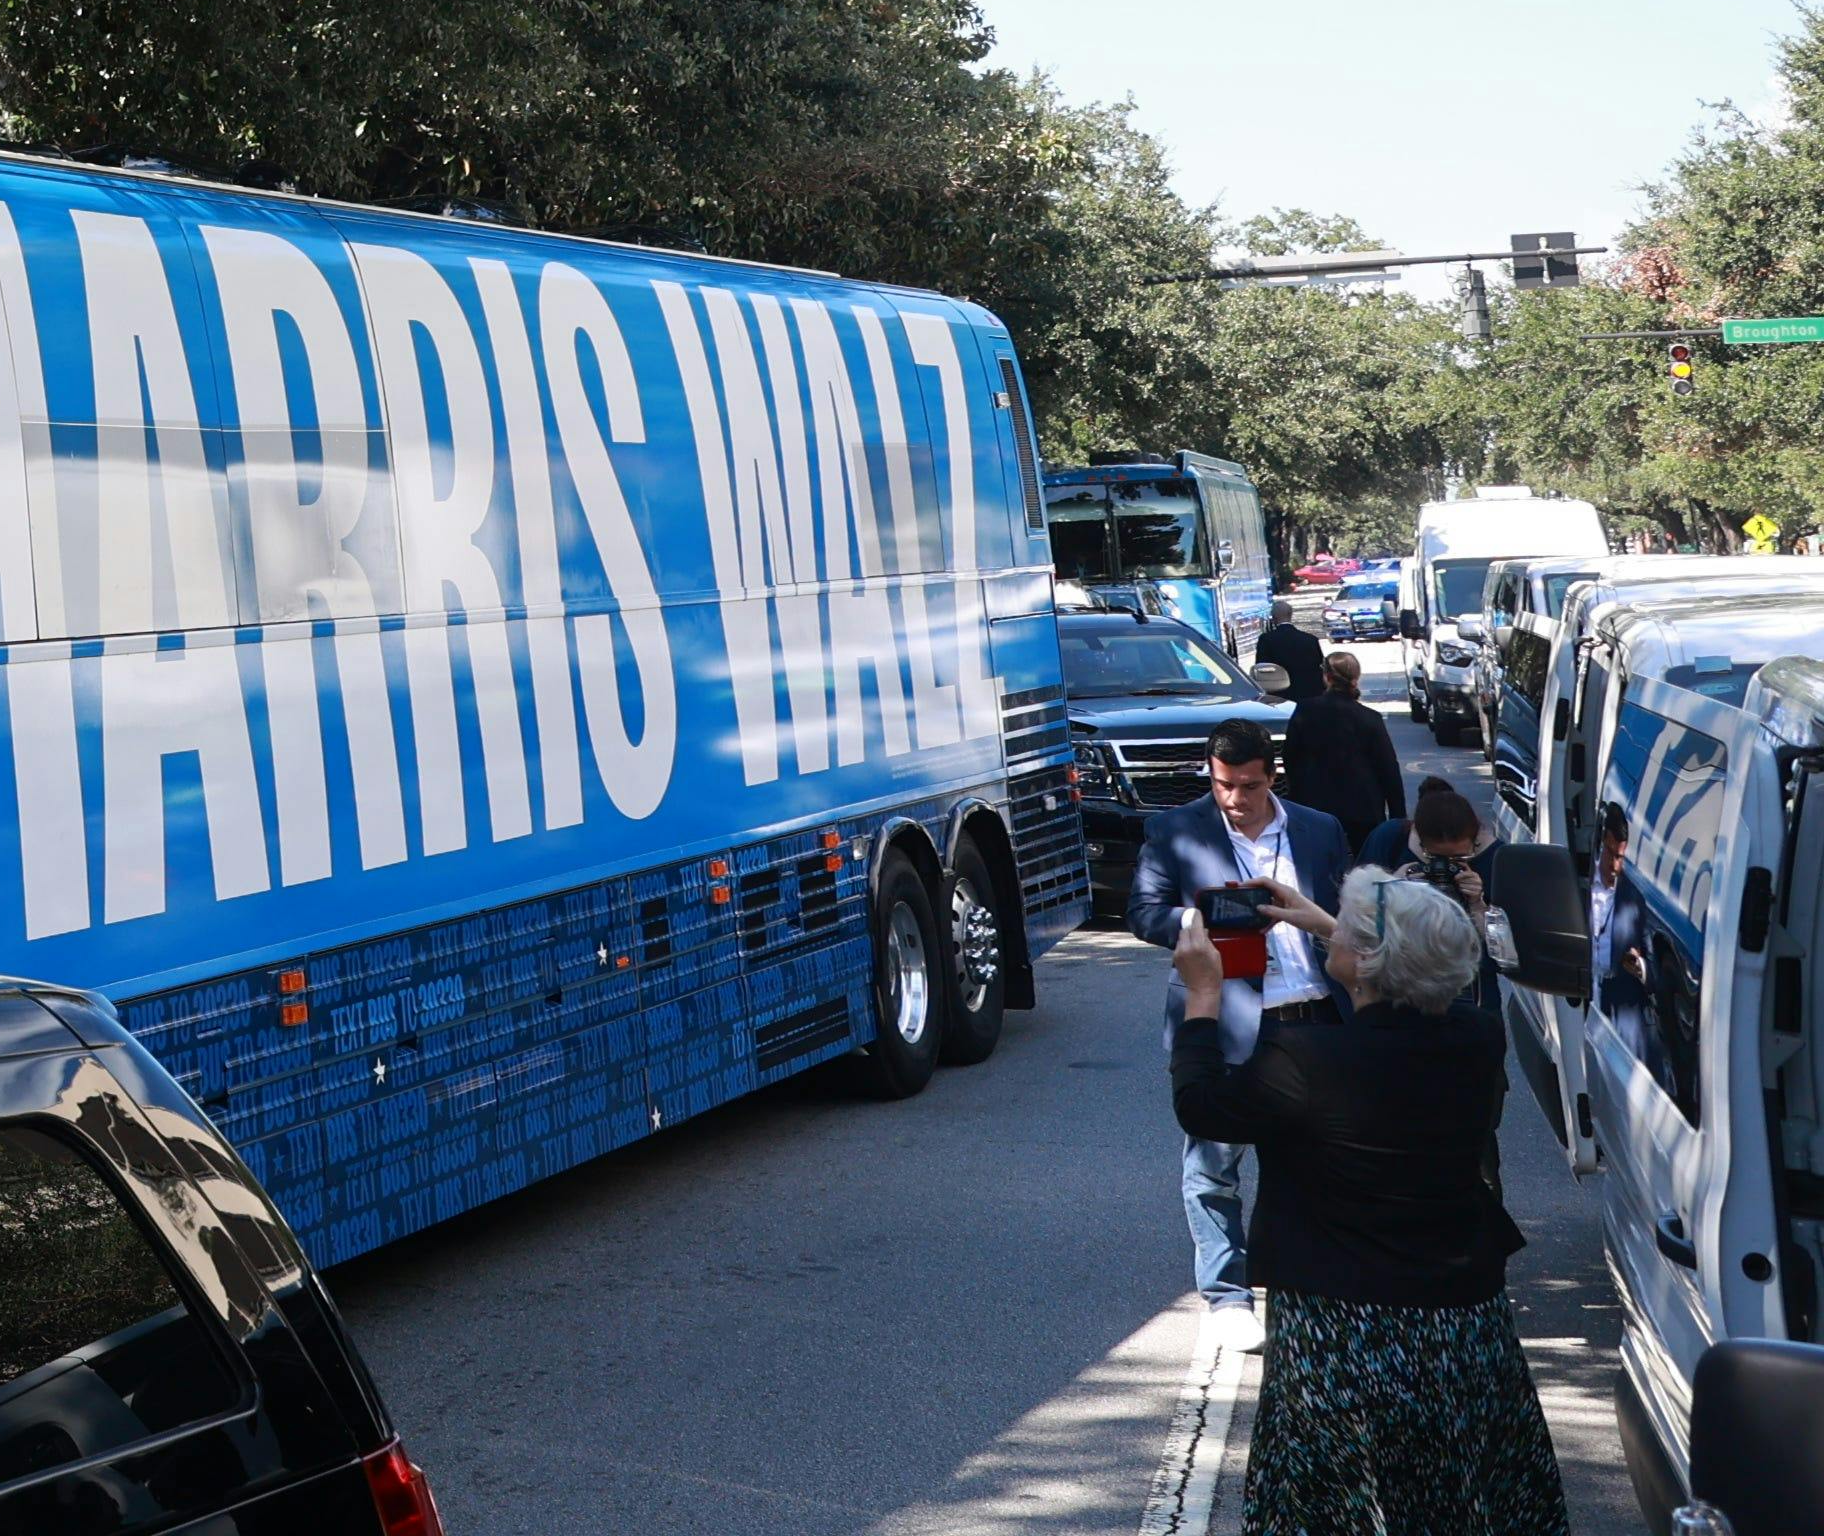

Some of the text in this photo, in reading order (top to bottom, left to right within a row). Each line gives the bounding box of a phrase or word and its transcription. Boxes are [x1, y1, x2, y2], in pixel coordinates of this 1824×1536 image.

[1733, 324, 1817, 340] Broughton
[648, 280, 1005, 787] WALZ
[330, 1001, 365, 1055] TEXT
[366, 994, 399, 1046] BUS
[398, 987, 418, 1035] TO
[286, 1121, 324, 1180] TEXT
[399, 1186, 434, 1240] TEXT
[434, 1174, 465, 1227] BUS
